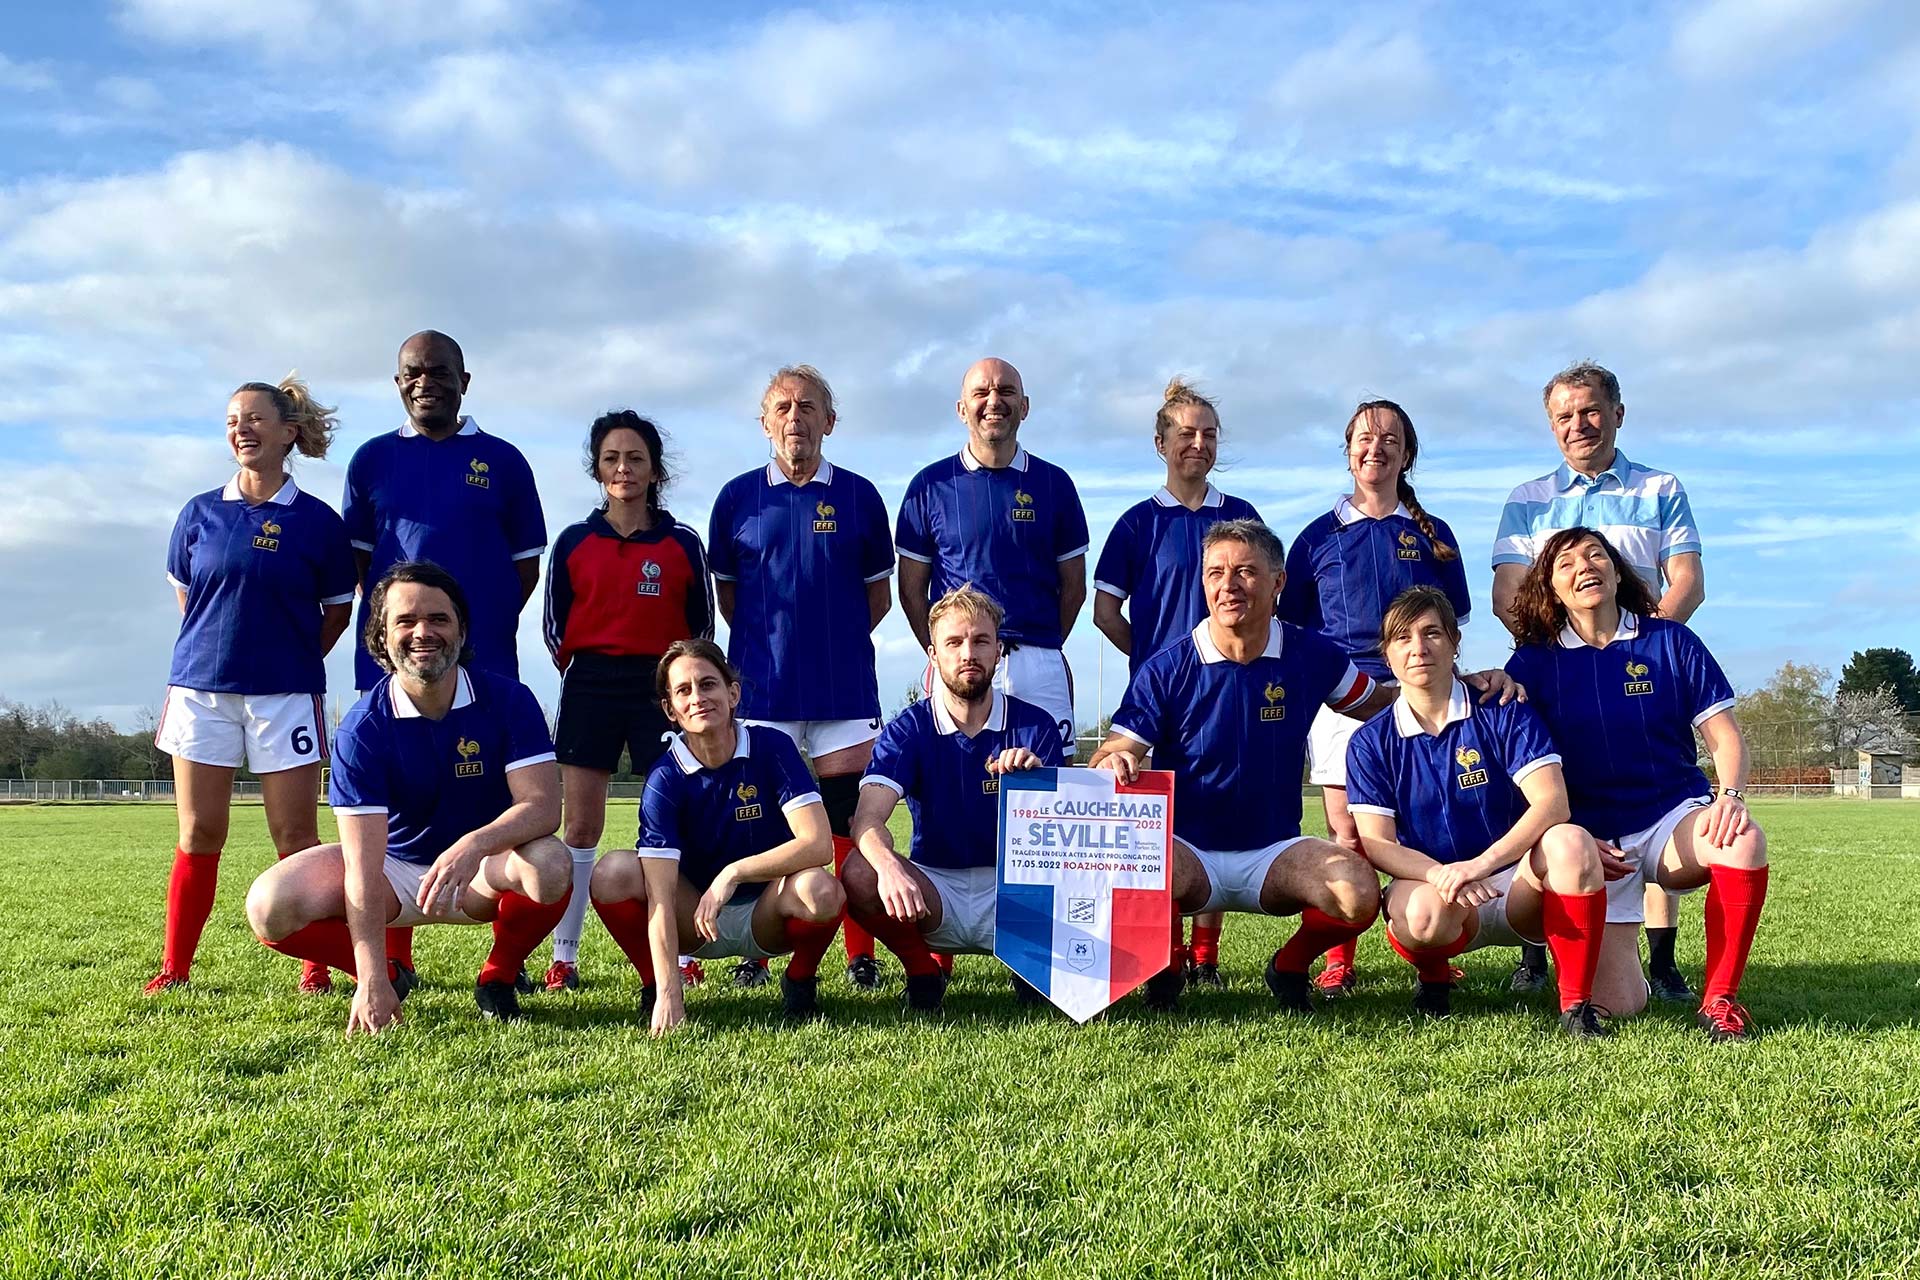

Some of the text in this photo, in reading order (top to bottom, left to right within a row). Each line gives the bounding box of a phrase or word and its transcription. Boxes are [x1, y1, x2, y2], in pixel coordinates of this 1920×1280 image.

[291, 726, 314, 755] 6
[1462, 772, 1485, 785] F.F.F.
[1013, 809, 1039, 819] 1982
[1040, 800, 1162, 819] LE CAUCHEMAR
[1135, 820, 1162, 830] 2022
[1011, 837, 1022, 846] DE
[1028, 819, 1130, 850] SÉVILLE
[1051, 850, 1067, 858] DEUX
[1068, 851, 1088, 859] ACTES
[1107, 853, 1161, 861] PROLONGATIONS
[1011, 860, 1161, 873] 17.05.2022 ROAZHON PARK 20H
